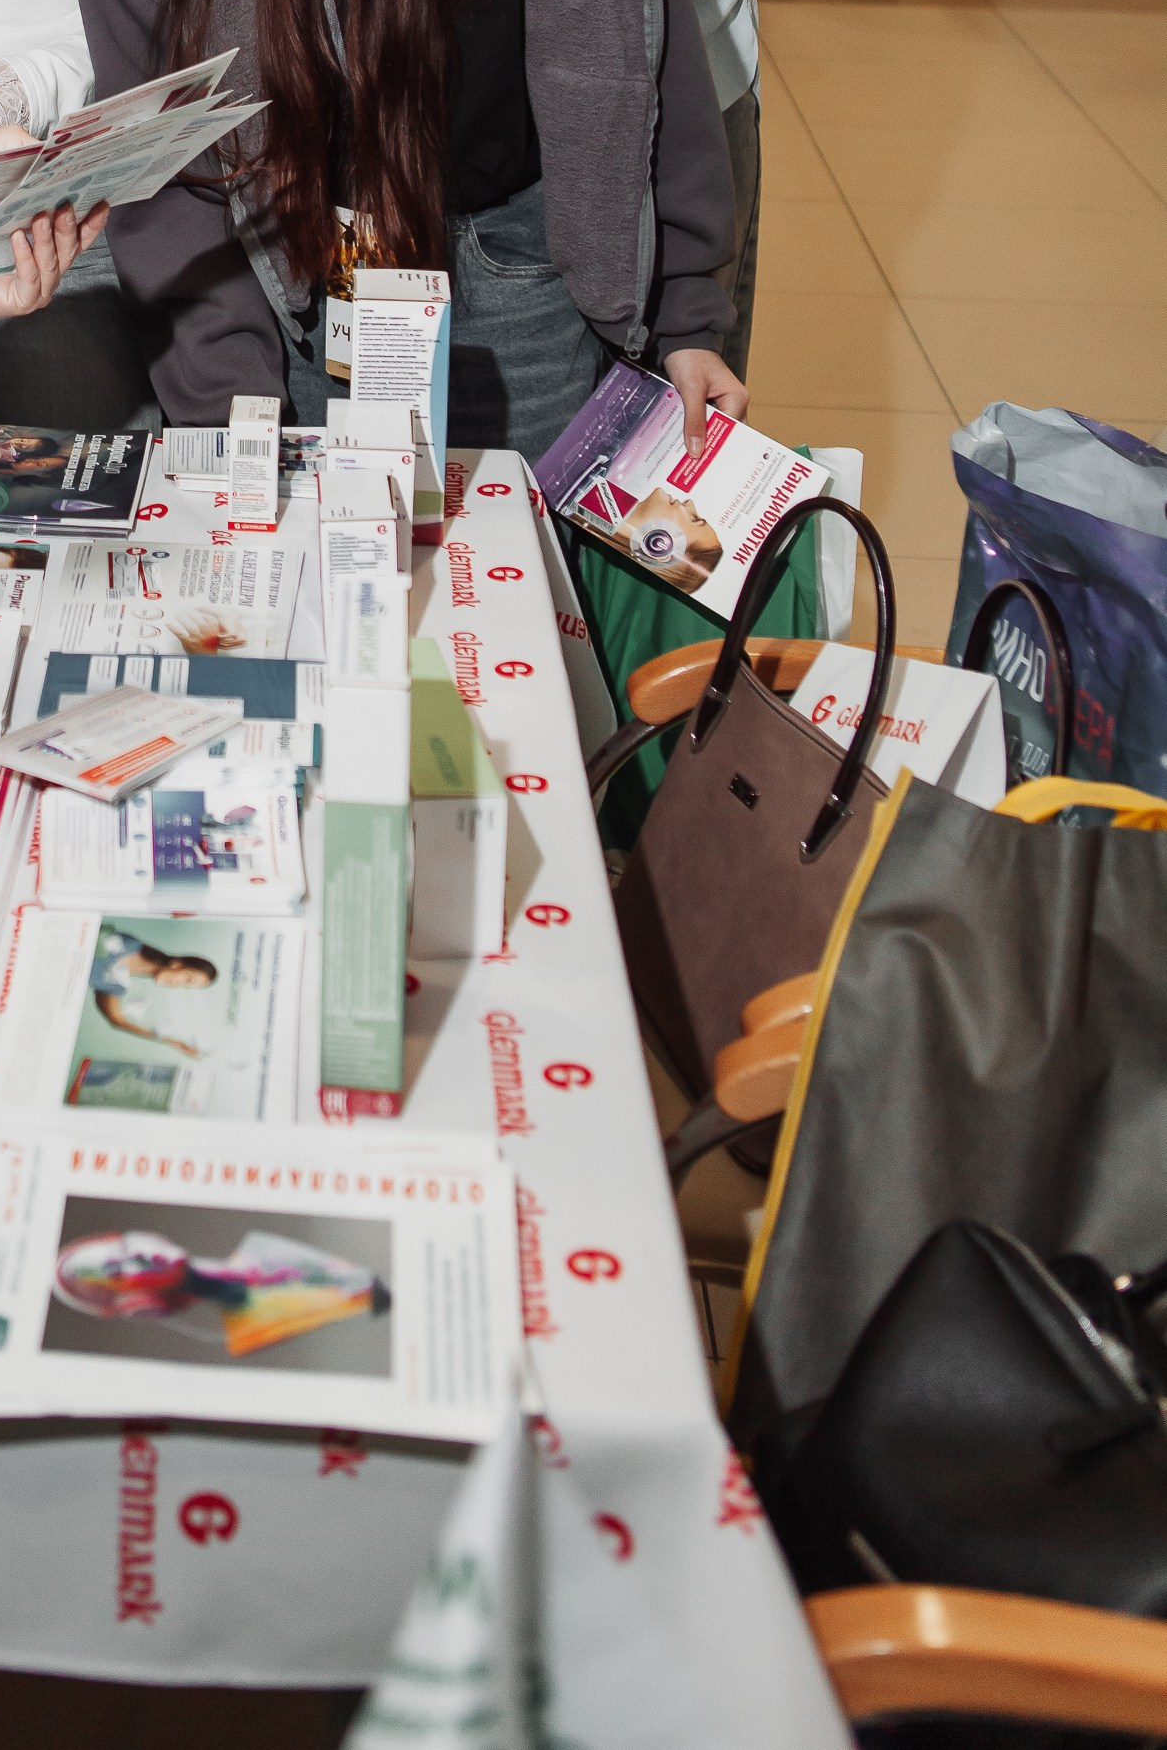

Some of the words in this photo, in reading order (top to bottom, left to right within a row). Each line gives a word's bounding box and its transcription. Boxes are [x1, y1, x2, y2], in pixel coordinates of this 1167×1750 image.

[731, 460, 813, 566] Кандибиотик
[836, 705, 928, 745] Glemark
[71, 1150, 485, 1205] ОТОРИНОЛАРИНГОЛОГИЯ
[114, 1419, 170, 1626] lenmark
